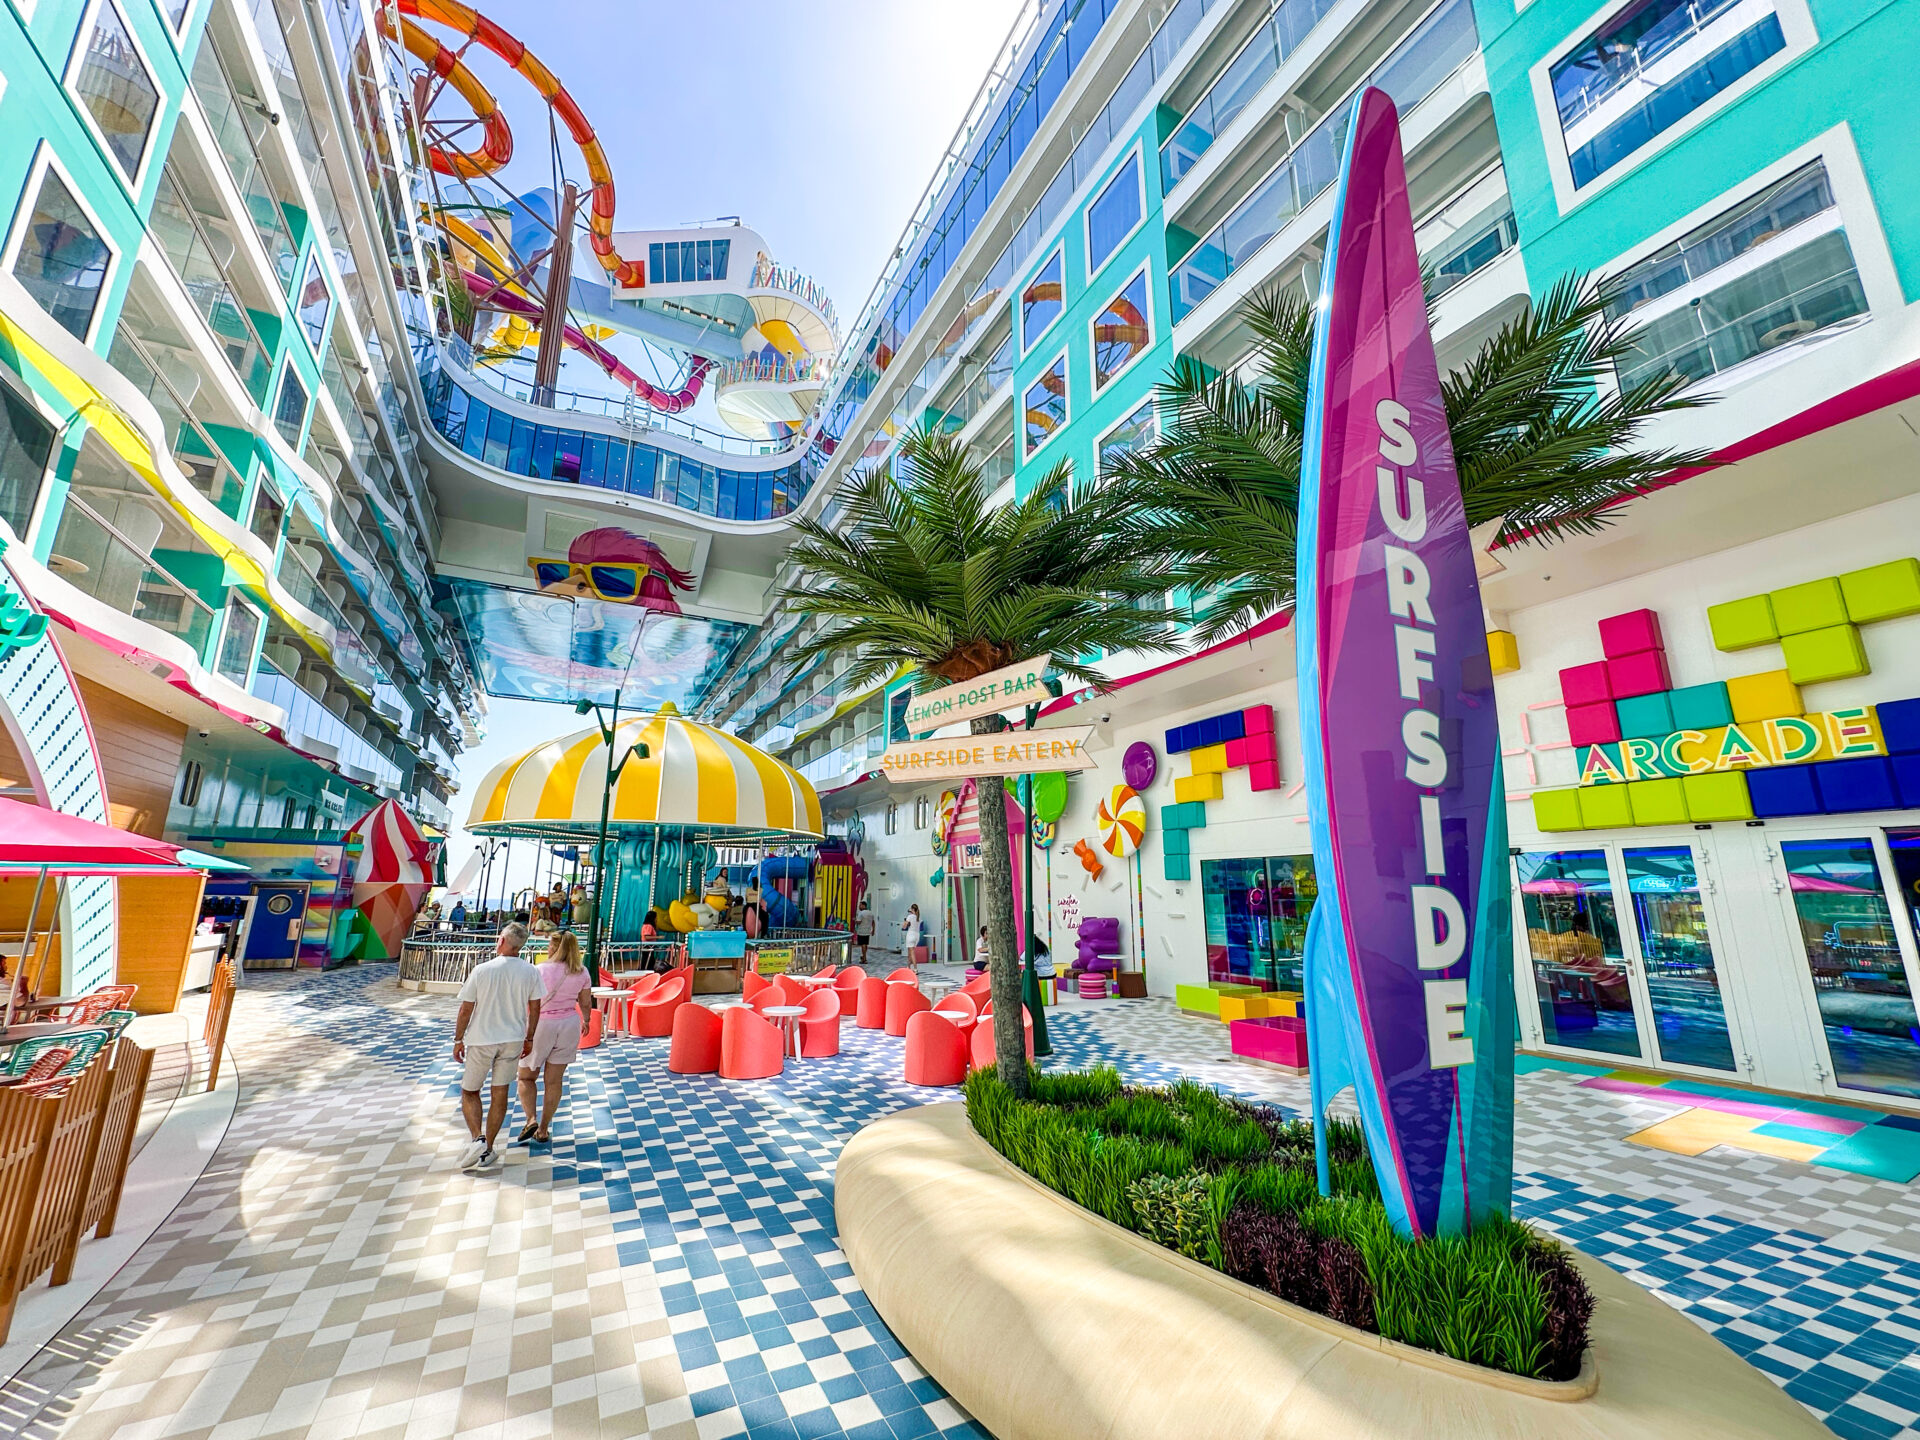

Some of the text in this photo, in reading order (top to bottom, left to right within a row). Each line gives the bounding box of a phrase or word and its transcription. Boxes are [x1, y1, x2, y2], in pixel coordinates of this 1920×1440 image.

[907, 672, 1037, 724] LEMON POST BAR
[883, 739, 1081, 771] SURFSIDE EATERY
[1376, 398, 1474, 1070] SURFSIDE
[1579, 706, 1879, 786] ARCADE
